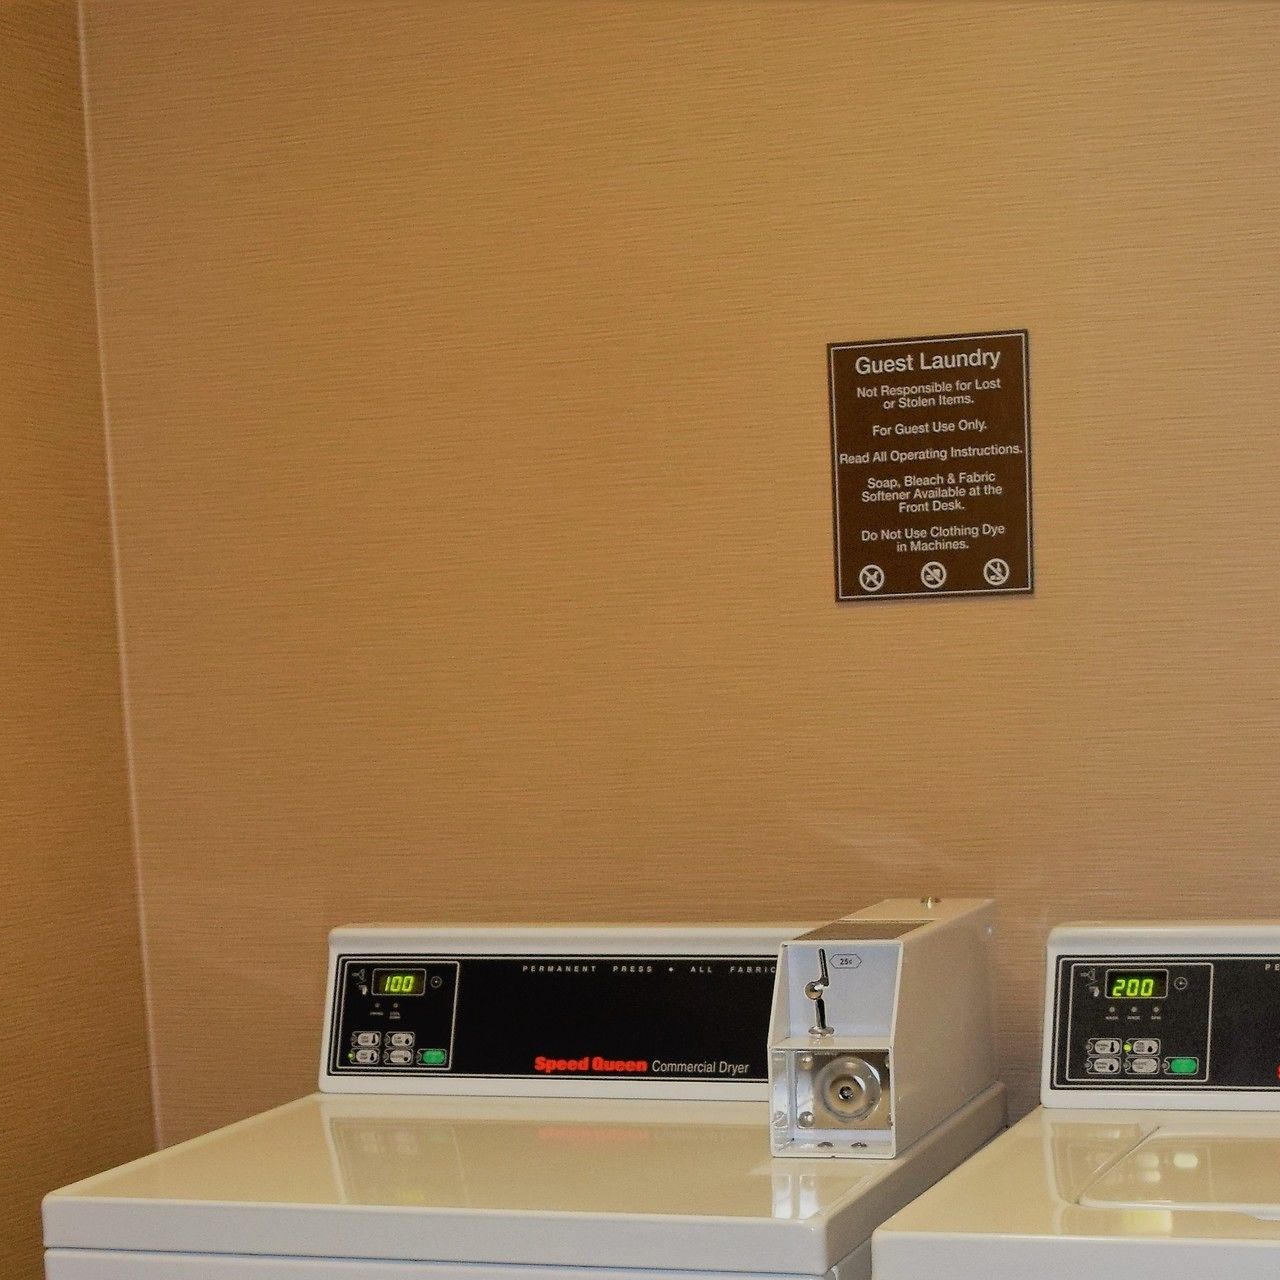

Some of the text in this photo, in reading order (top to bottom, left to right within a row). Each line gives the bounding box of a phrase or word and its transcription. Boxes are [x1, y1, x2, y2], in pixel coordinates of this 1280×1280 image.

[855, 348, 1001, 375] Guest Laundry
[856, 378, 1001, 398] Not Responsible for Lost
[883, 395, 974, 410] or Stolen Items.
[872, 419, 987, 437] For Guest Use Only.
[839, 444, 1023, 465] Read All Operating Instructions.
[867, 471, 996, 490] Soap, Bleach & Fabric
[861, 484, 1003, 503] Softener Available at the
[898, 500, 965, 513] Front Desk.
[861, 523, 1005, 541] Do Not Use Clothing Dye
[896, 540, 969, 552] in Machines.
[522, 965, 776, 974] PERMANENT PRESS ALL FABRIC
[384, 975, 415, 992] 100
[1112, 978, 1154, 997] 200
[534, 1056, 749, 1076] Speed Queen Commercial Dryer
